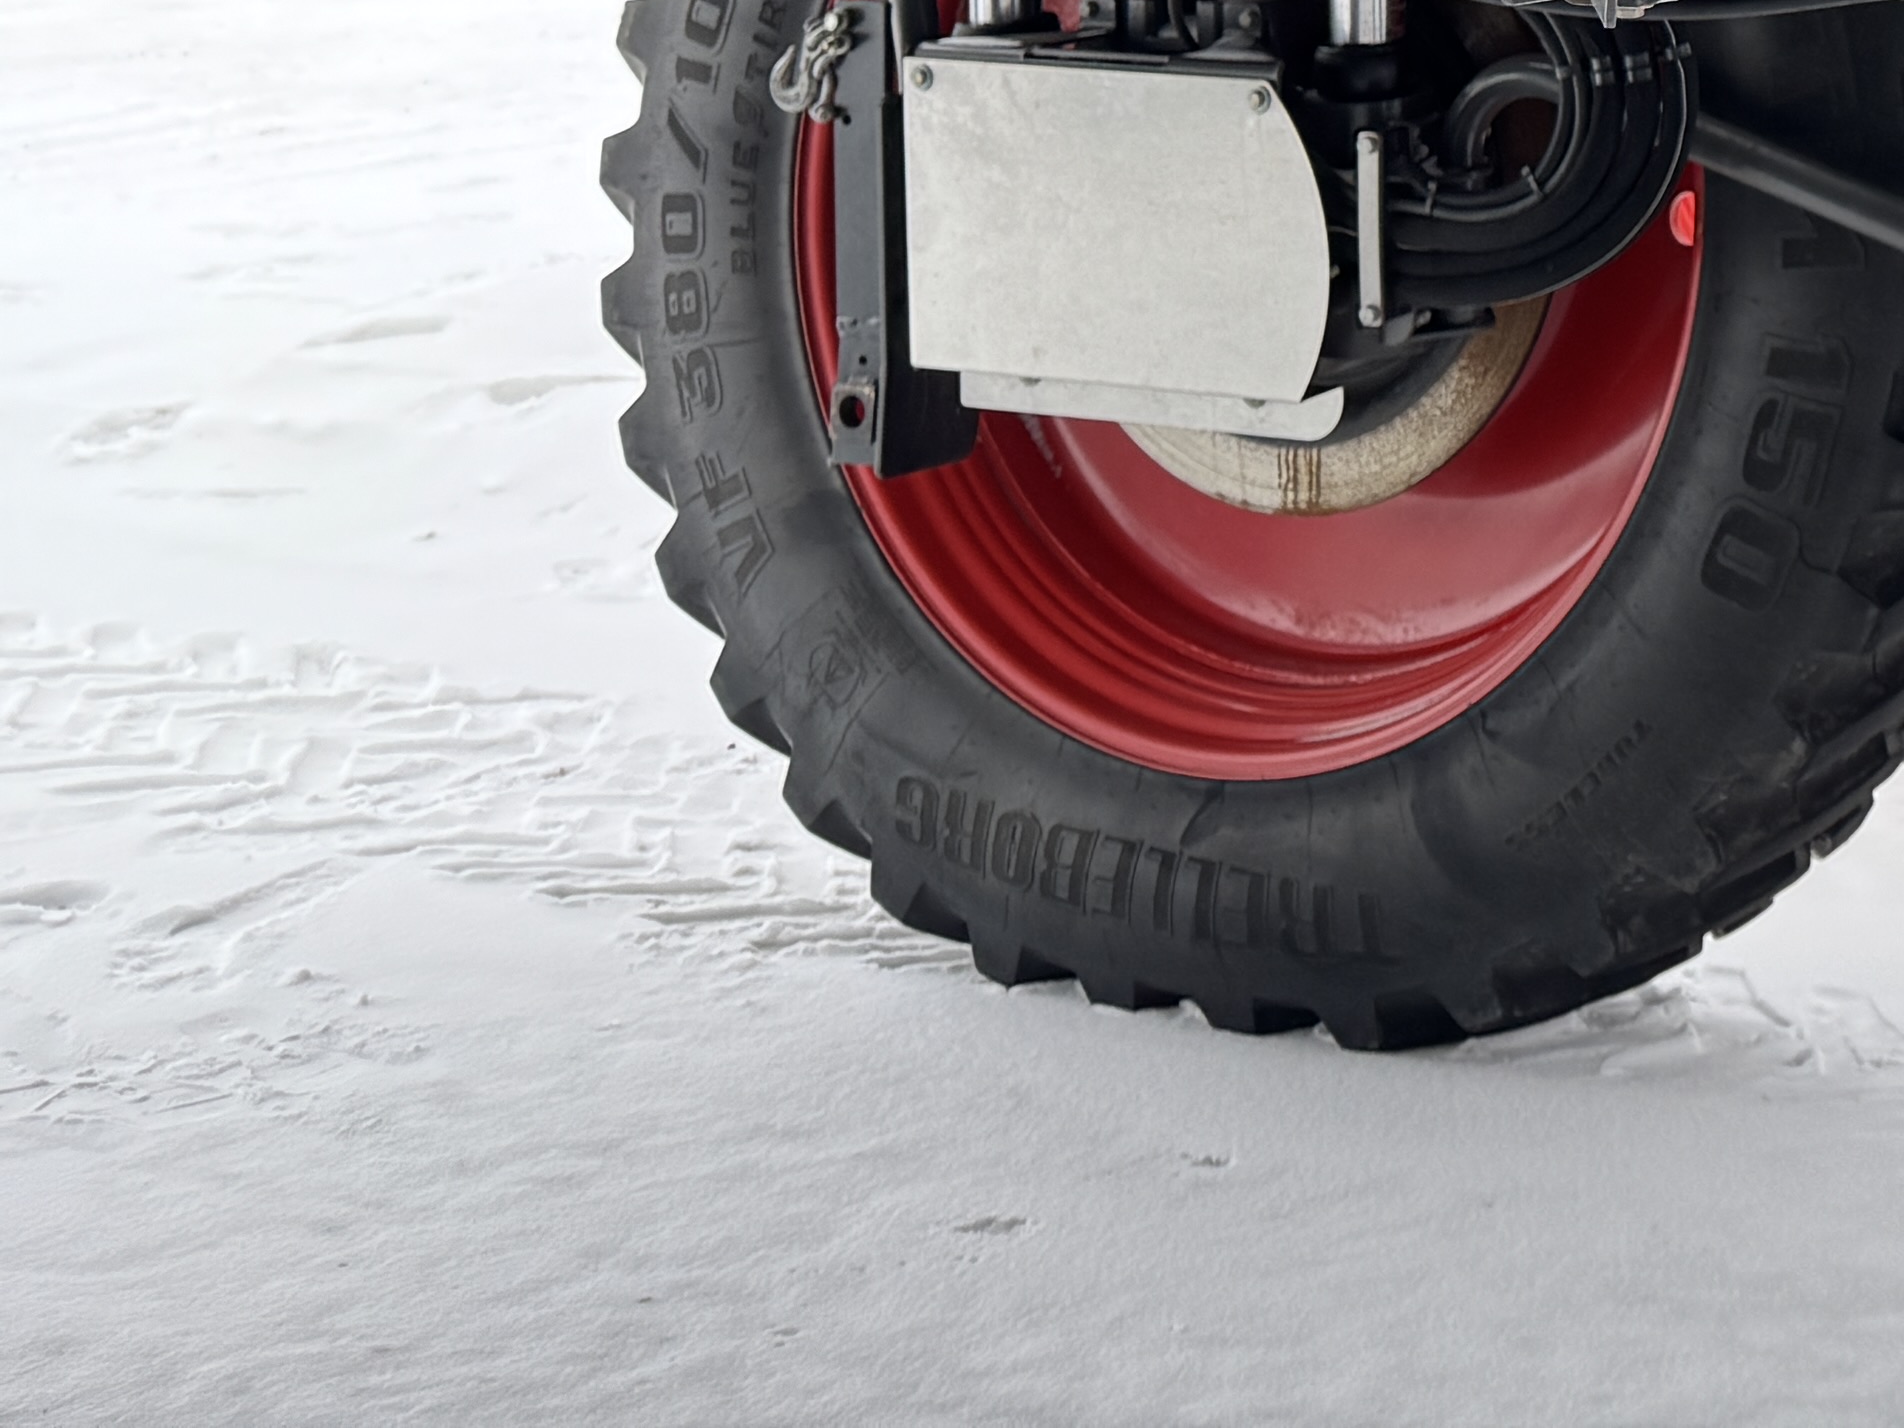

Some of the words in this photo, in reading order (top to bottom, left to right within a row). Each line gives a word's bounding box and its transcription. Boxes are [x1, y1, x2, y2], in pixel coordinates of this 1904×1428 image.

[730, 144, 758, 277] BLUE
[695, 451, 775, 604] VF
[894, 774, 1399, 959] TRELLEBORG
